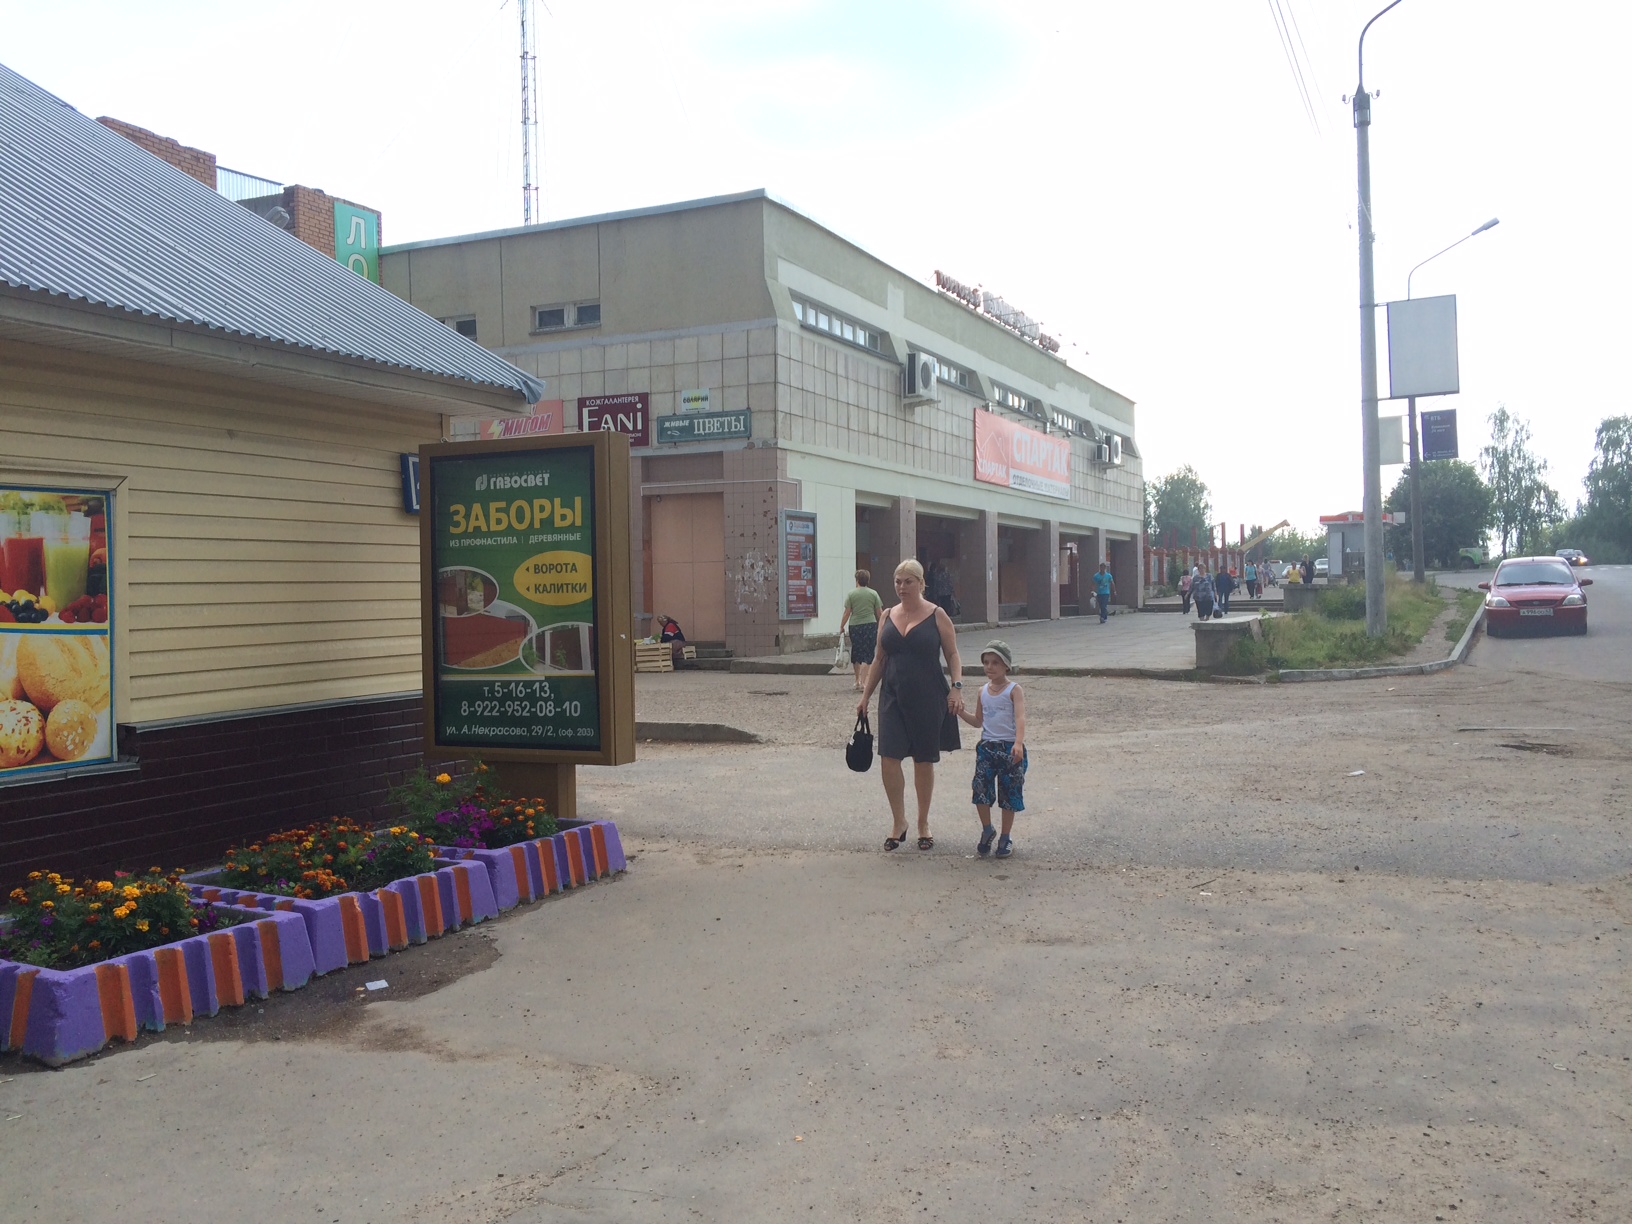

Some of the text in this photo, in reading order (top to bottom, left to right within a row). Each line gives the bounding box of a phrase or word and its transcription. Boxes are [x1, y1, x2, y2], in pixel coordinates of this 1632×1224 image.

[586, 396, 639, 406] КОЖГАЛАНТЕРЕЯ
[664, 416, 745, 435] ЖИВЫЕ ЦВЕТЫ
[1013, 430, 1069, 476] СПАРТАК
[979, 458, 1007, 478] СПАРТАК
[490, 473, 550, 490] ГАЗОСВЕТ
[449, 496, 582, 534] ЗАБОРЫ
[449, 533, 582, 547] ИЗ ПРОФНАСТИЛА ДЕРЕВЯННЫЕ
[533, 562, 578, 574] ВОРОТА
[534, 582, 587, 594] КАЛИТКИ
[494, 681, 555, 699] 5-16-13,
[460, 700, 581, 716] 8-922-952-08-10
[446, 724, 595, 737] ул. А.Некрасова, 29/2, (оф. 203)
